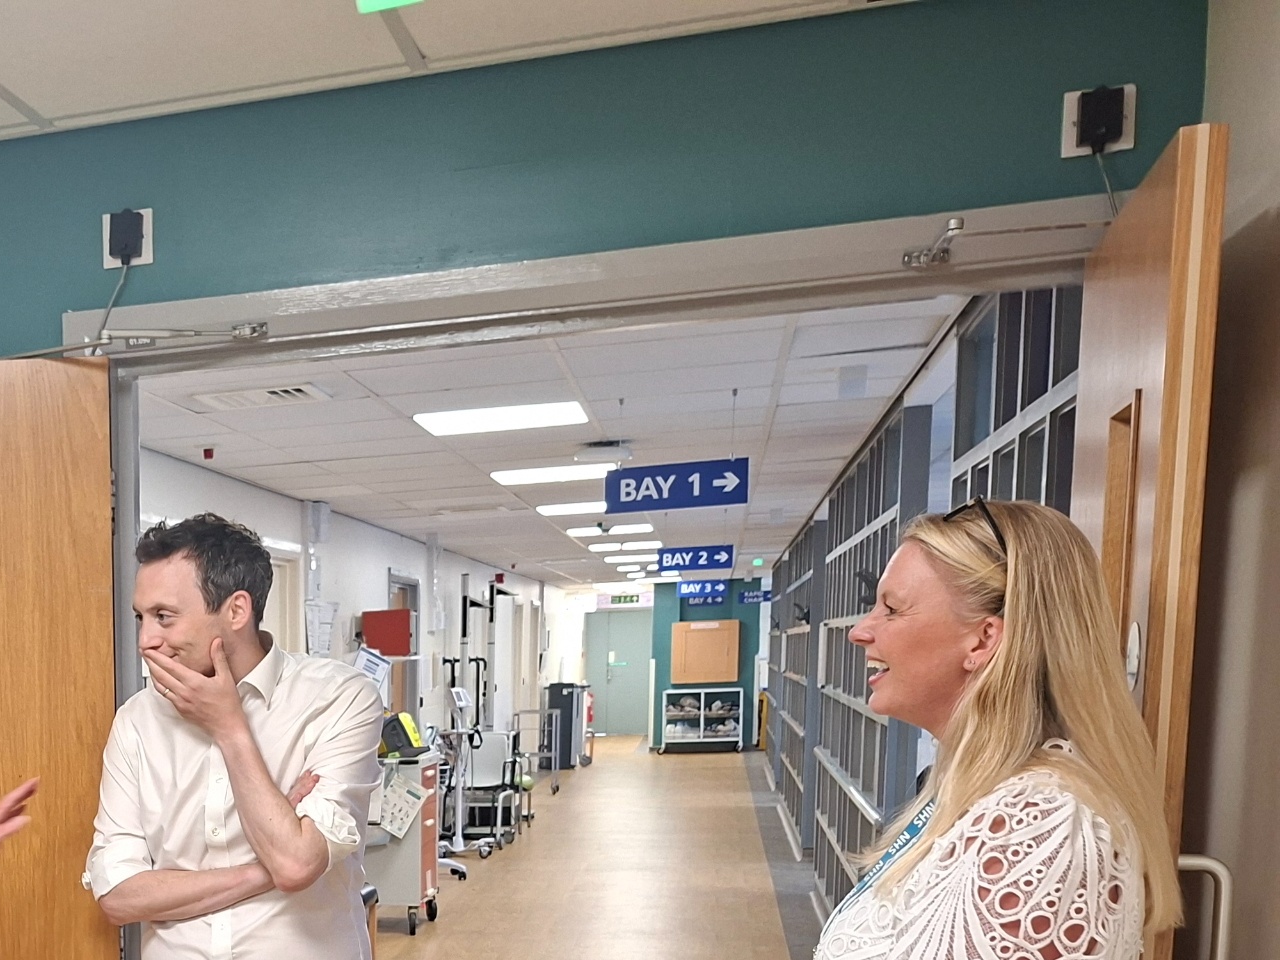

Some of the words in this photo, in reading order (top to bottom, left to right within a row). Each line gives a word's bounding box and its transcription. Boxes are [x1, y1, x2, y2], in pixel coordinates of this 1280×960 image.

[620, 475, 676, 502] BAY
[688, 473, 700, 496] 1
[662, 551, 693, 566] BAY
[698, 551, 708, 565] 2
[681, 583, 701, 594] BAY
[704, 582, 712, 593] 3
